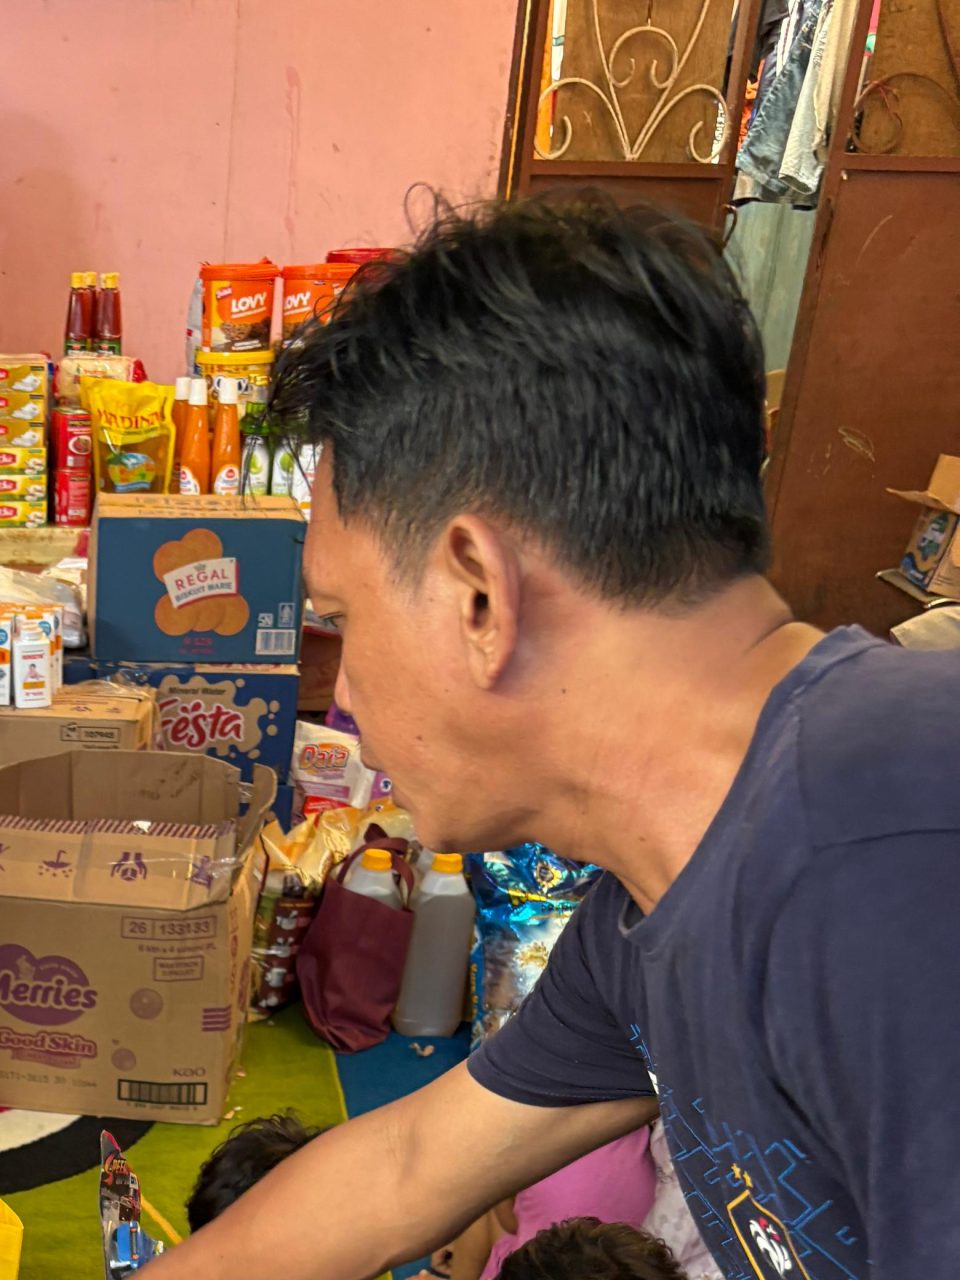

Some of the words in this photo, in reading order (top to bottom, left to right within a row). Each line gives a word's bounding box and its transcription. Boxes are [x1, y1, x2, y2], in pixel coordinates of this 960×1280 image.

[231, 291, 268, 313] LOVY
[174, 568, 230, 591] REGAL
[201, 687, 227, 696] Water
[128, 920, 147, 934] 26
[159, 919, 210, 936] 133133
[47, 1034, 97, 1058] Skin
